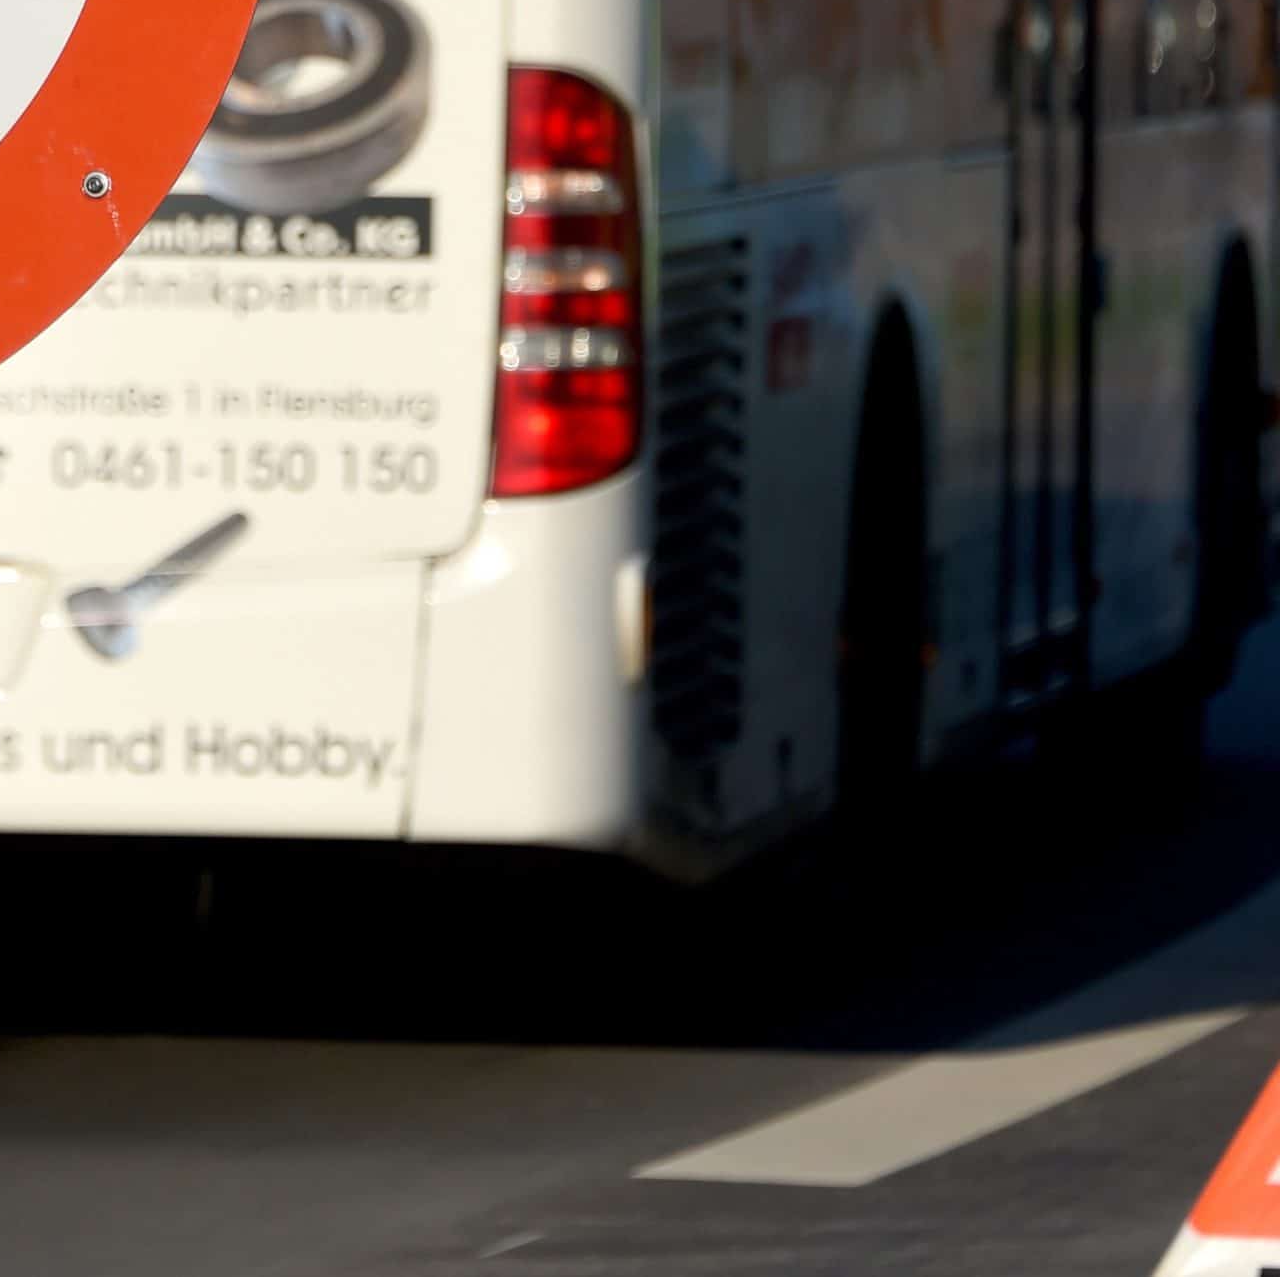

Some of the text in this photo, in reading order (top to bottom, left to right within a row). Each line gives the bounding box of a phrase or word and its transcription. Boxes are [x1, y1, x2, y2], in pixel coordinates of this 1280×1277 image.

[128, 215, 239, 256] mbH
[241, 215, 276, 256] &
[355, 216, 420, 257] KG
[78, 268, 436, 317] chnikpartner
[50, 439, 438, 493] 0461-150 150
[41, 723, 165, 776] und
